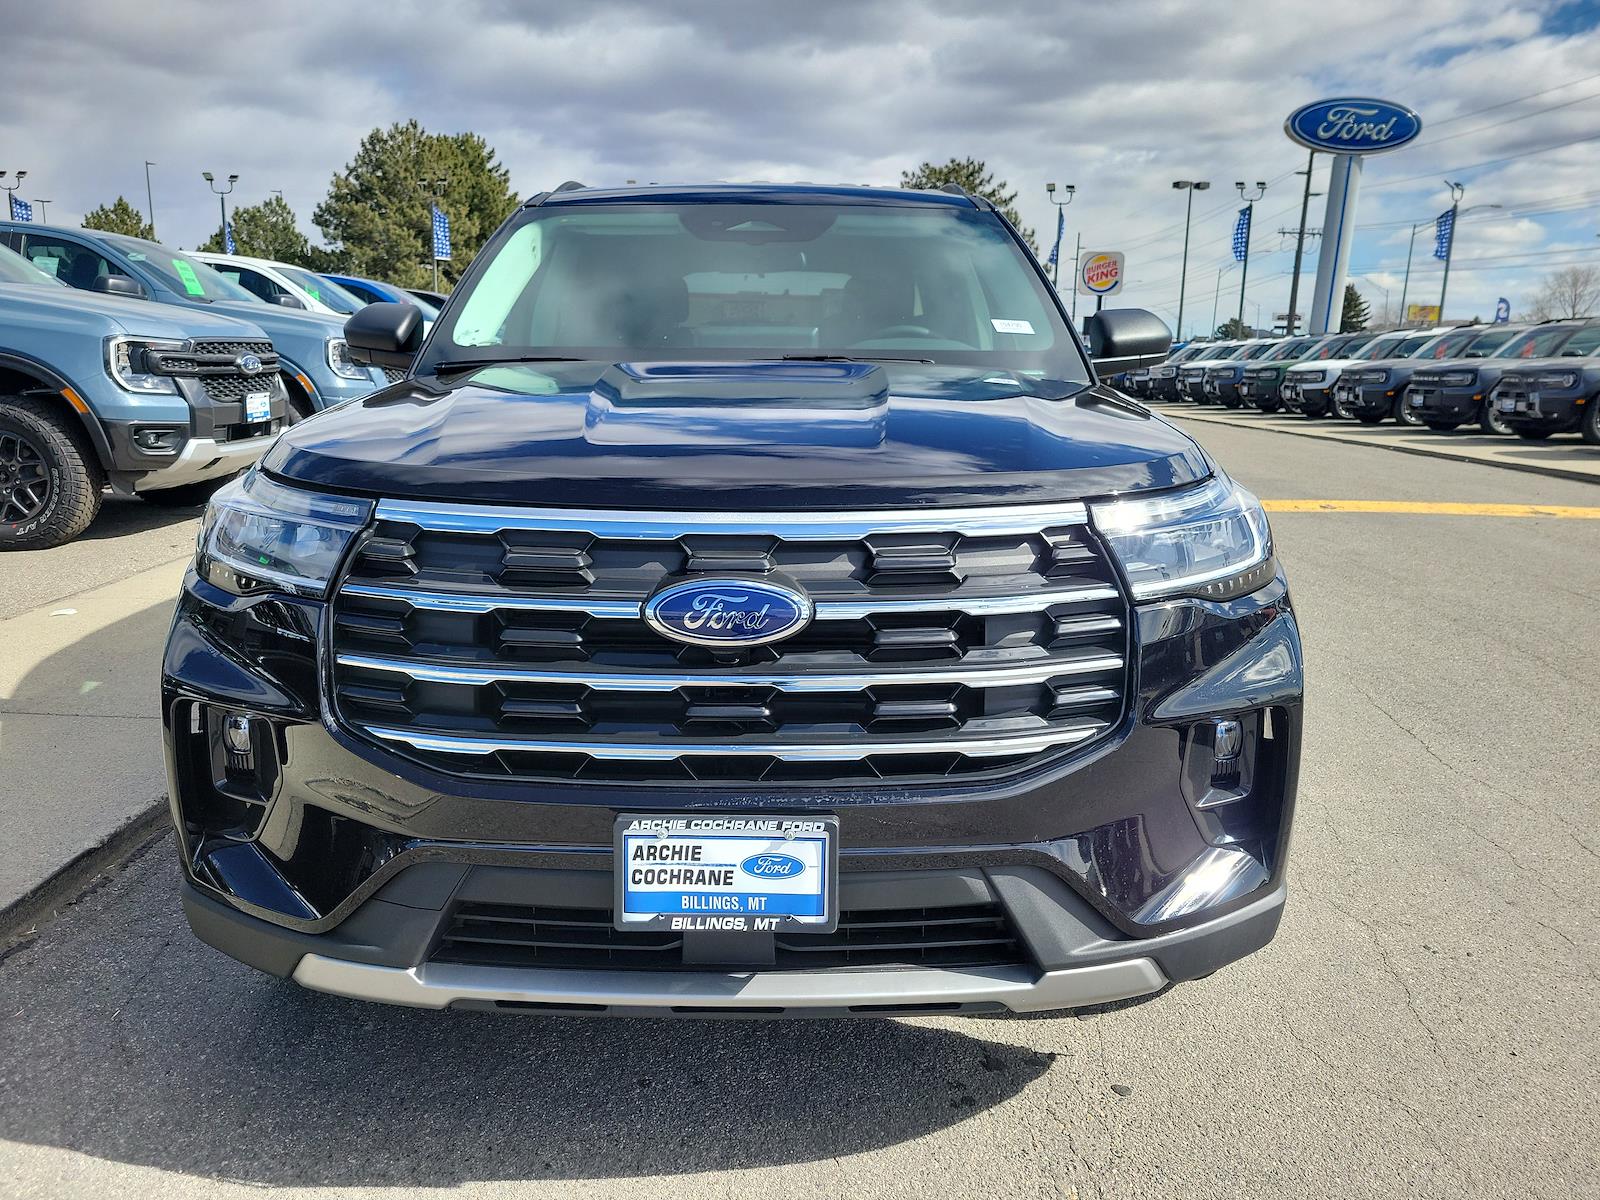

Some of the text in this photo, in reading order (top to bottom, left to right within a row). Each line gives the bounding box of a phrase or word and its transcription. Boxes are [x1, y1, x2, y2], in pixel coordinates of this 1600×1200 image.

[1317, 106, 1398, 141] Ford
[1086, 260, 1117, 274] BURGER
[1087, 268, 1118, 285] KING
[683, 593, 771, 630] Ford
[628, 819, 825, 832] ARCHIE COCHRANE FORD
[632, 845, 702, 861] ARCHIE
[753, 856, 793, 875] Ford
[631, 868, 734, 886] COCHRANE
[681, 896, 768, 912] BILLINGS, MT
[671, 917, 781, 932] BILLINGS, MT
